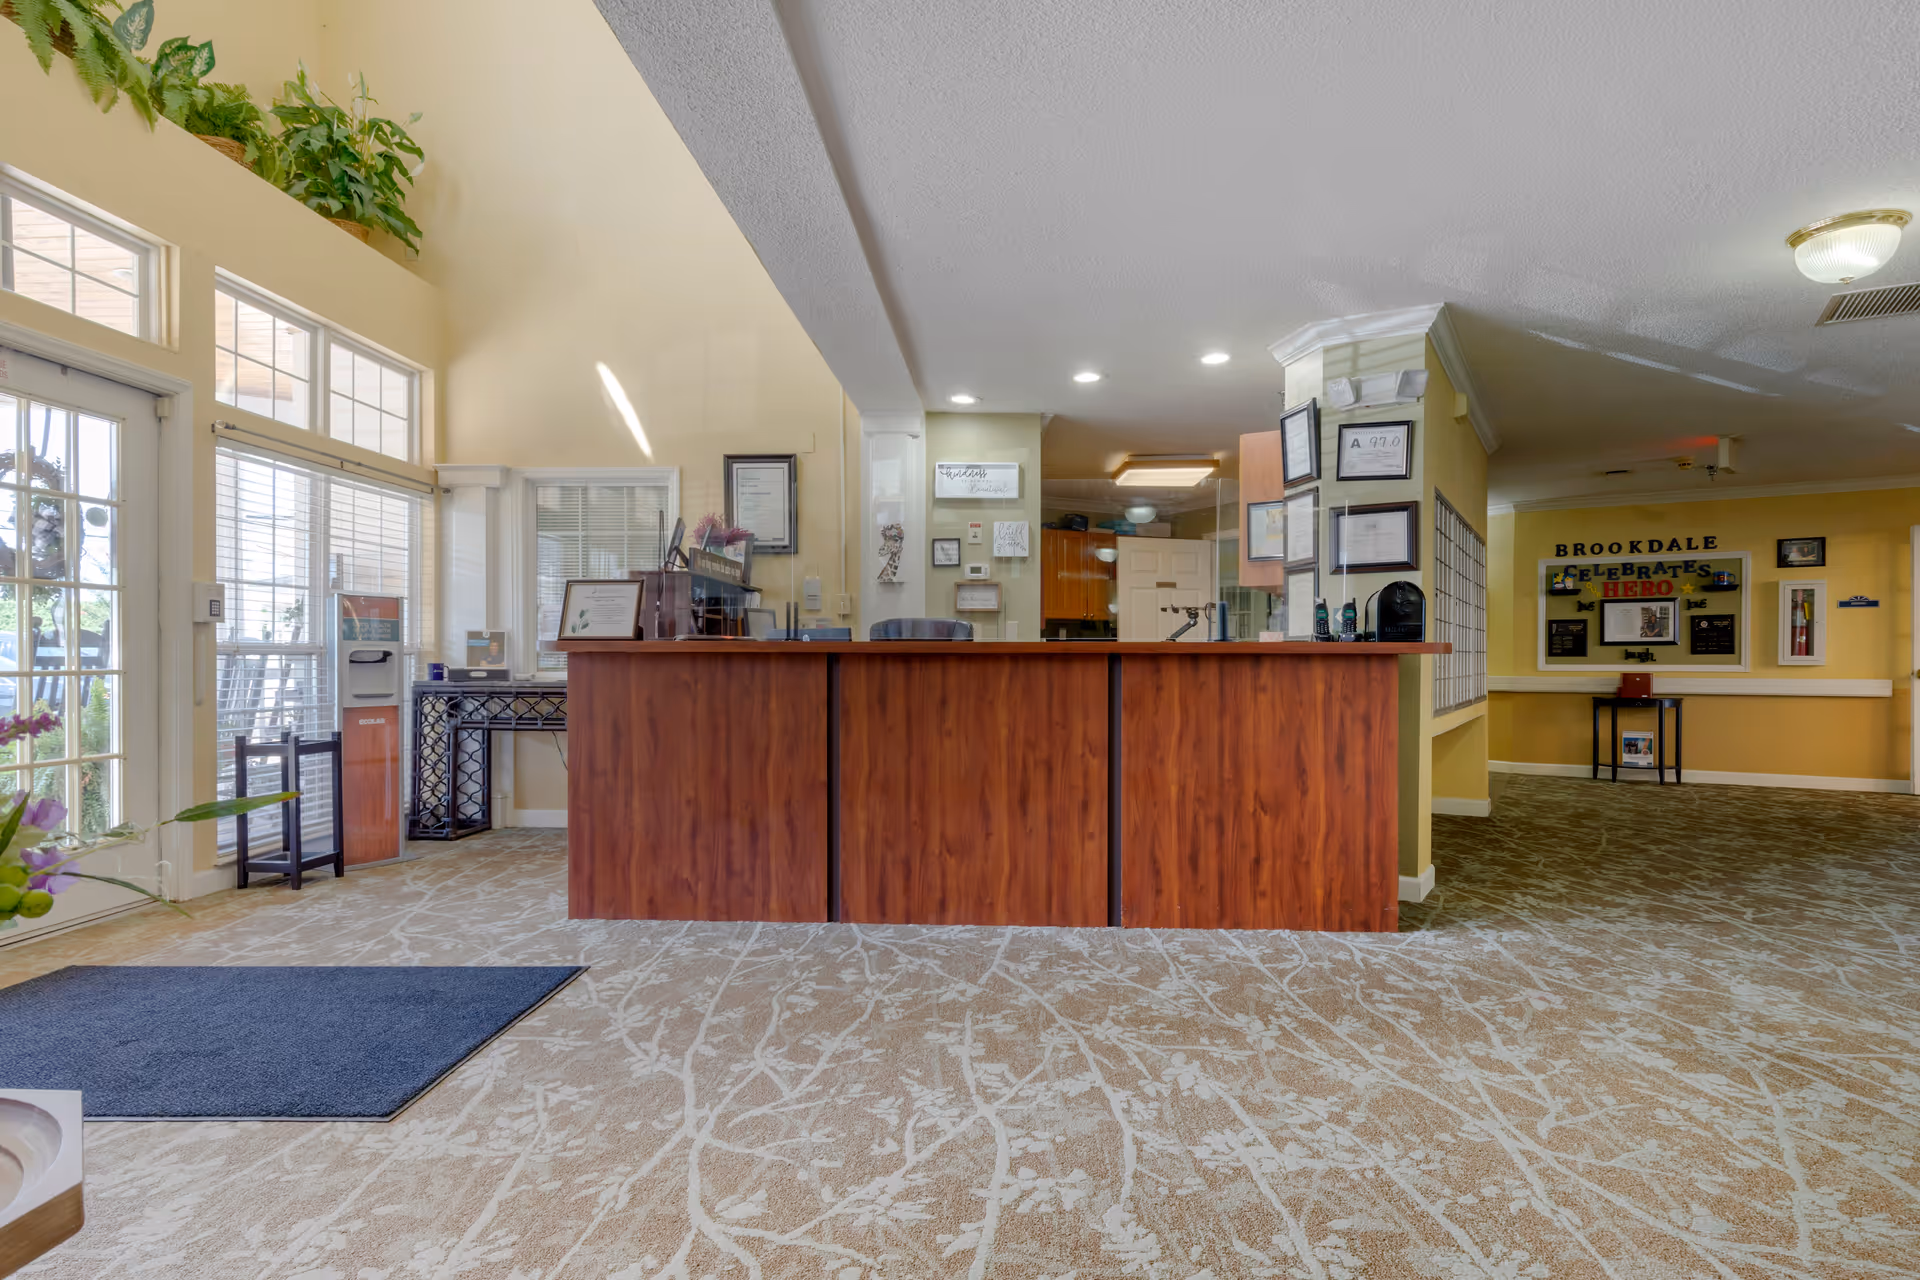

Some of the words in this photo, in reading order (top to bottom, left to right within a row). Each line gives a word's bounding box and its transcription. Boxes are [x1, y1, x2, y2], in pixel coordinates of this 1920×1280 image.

[1350, 437, 1361, 448] A
[1369, 436, 1401, 448] 97.0
[1555, 536, 1718, 557] BROOKDALE
[1563, 559, 1712, 582] CELEBRATES
[1602, 579, 1674, 598] HERO
